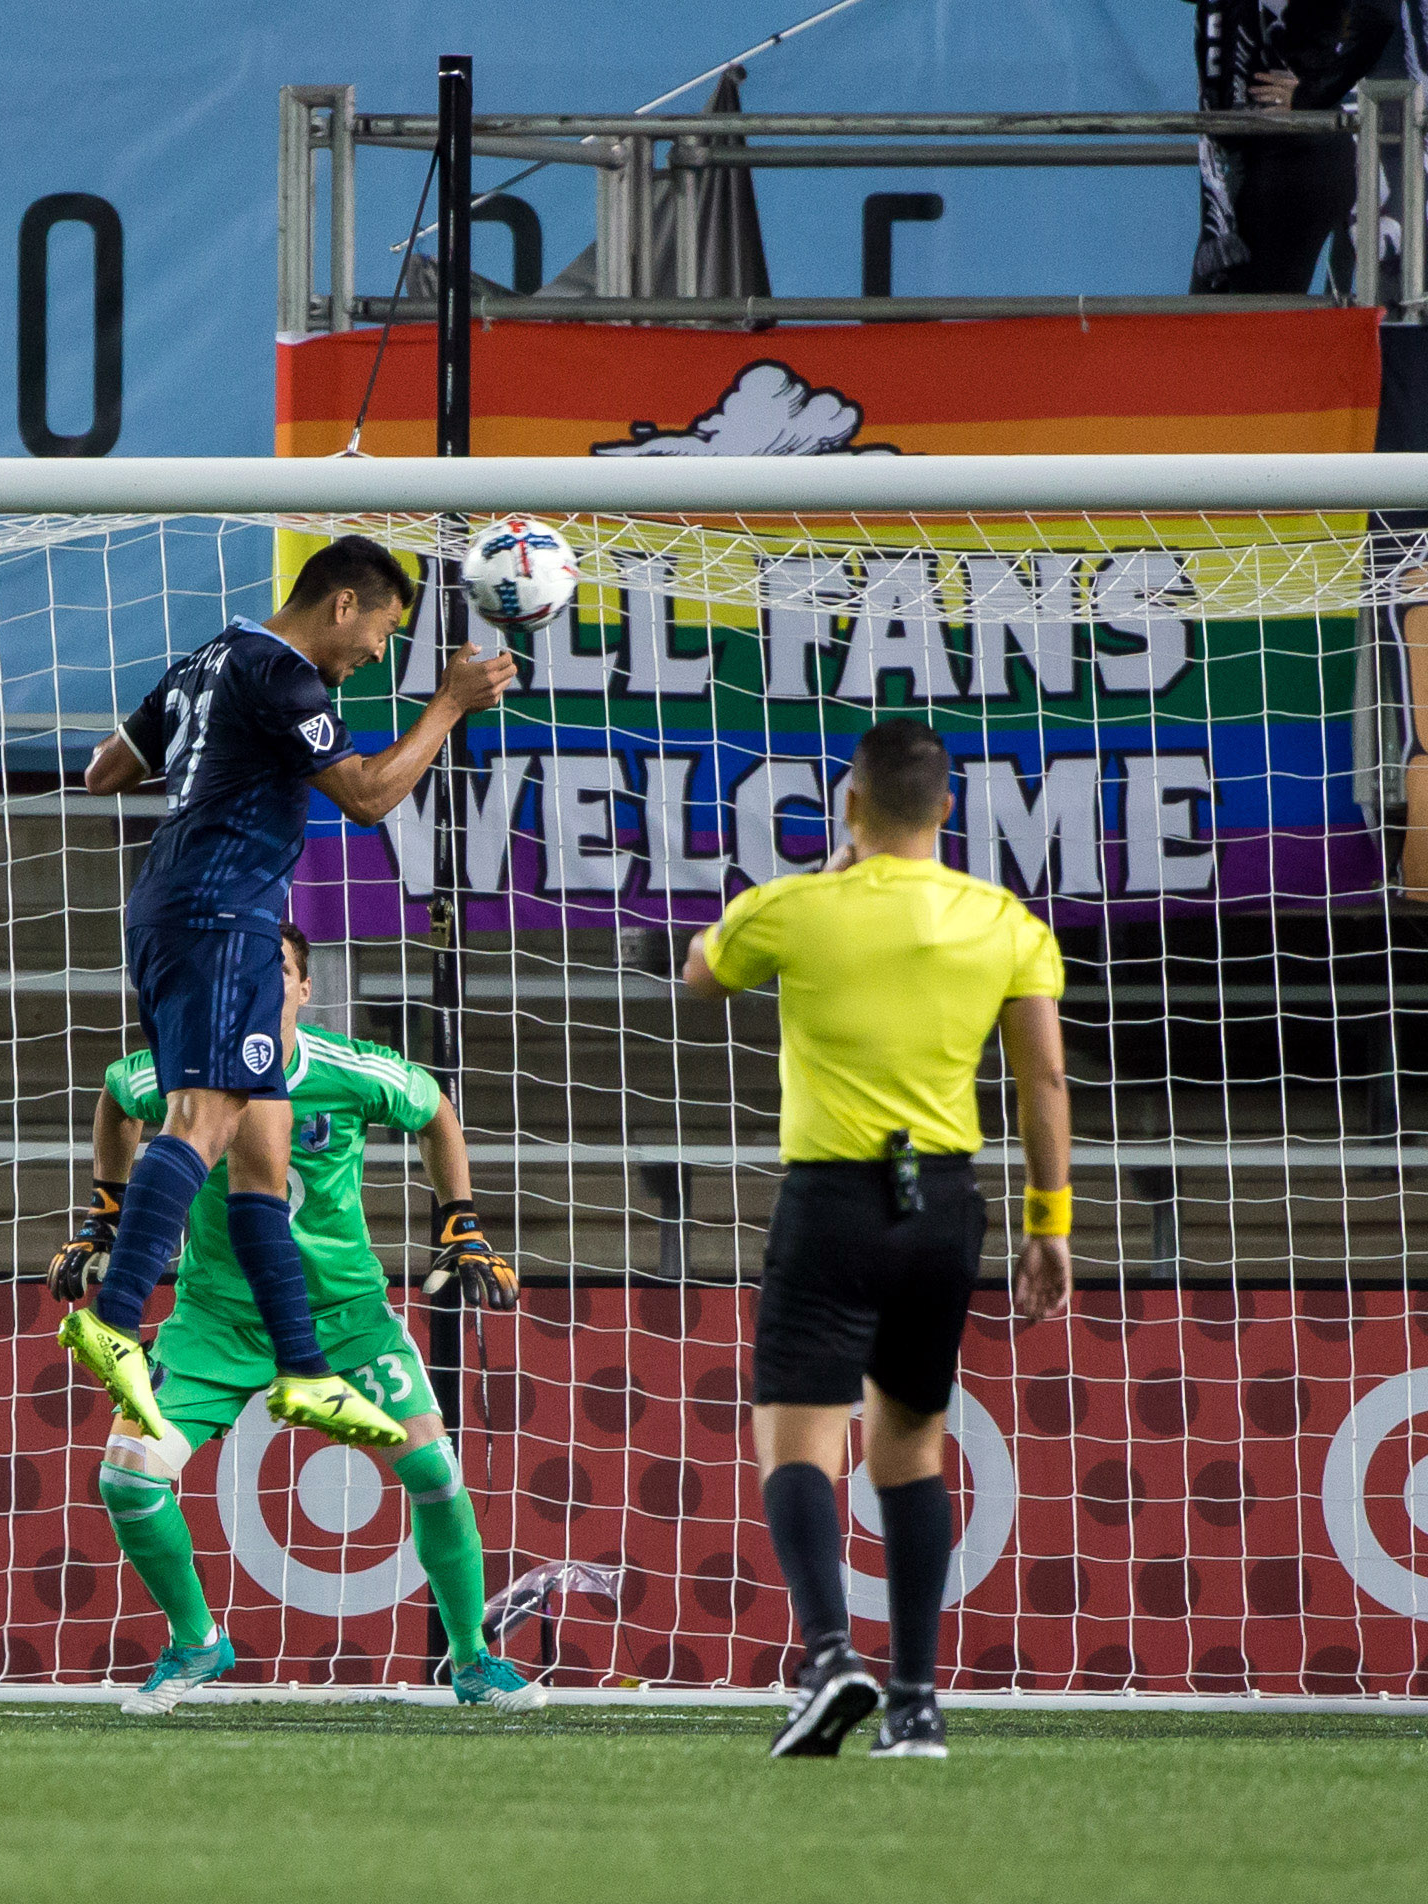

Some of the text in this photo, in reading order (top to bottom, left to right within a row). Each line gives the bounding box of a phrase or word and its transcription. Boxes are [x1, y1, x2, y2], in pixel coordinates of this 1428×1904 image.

[760, 554, 1196, 699] FANS
[377, 753, 1222, 897] WELCME
[355, 1354, 412, 1408] 33
